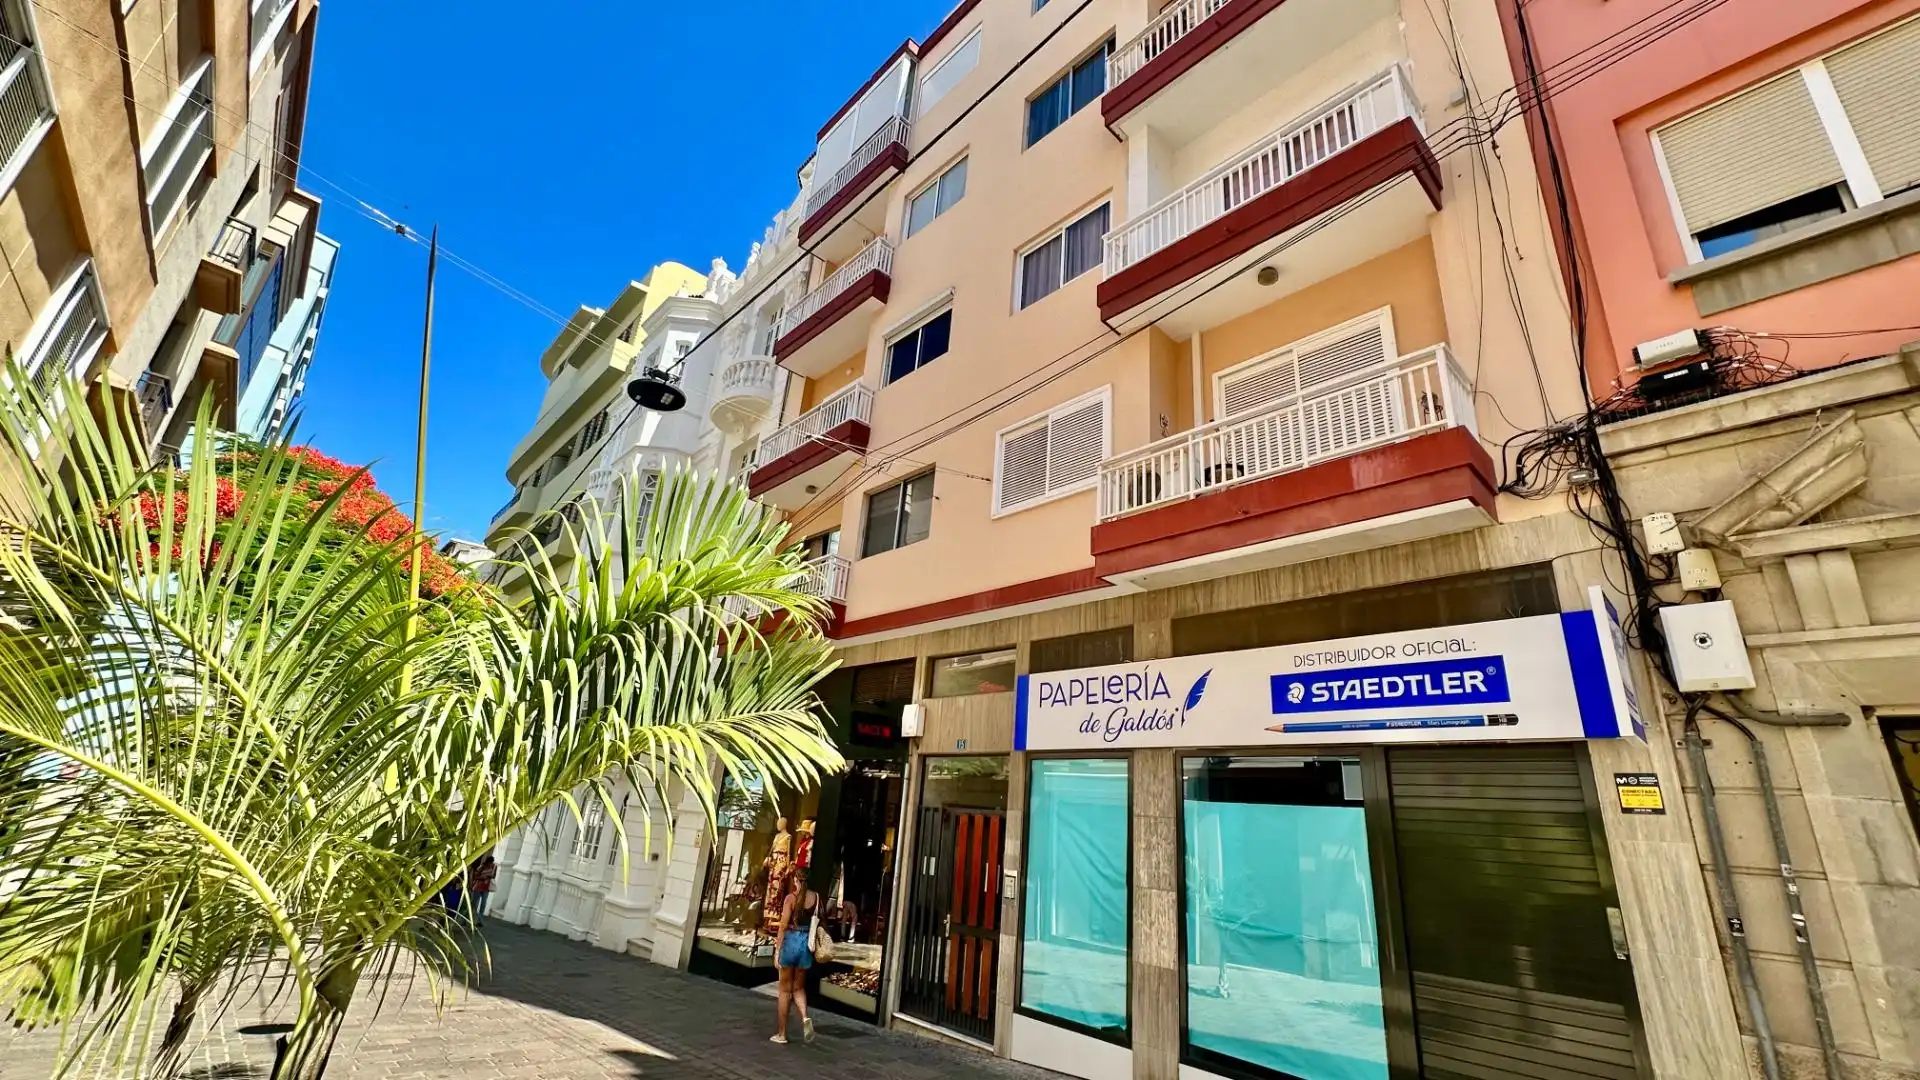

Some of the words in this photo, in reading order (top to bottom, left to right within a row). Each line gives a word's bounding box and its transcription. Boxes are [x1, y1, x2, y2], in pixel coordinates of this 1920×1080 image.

[1293, 645, 1396, 668] DISTRIBUIDOR
[1079, 712, 1101, 733] de
[1103, 706, 1175, 743] Galdós
